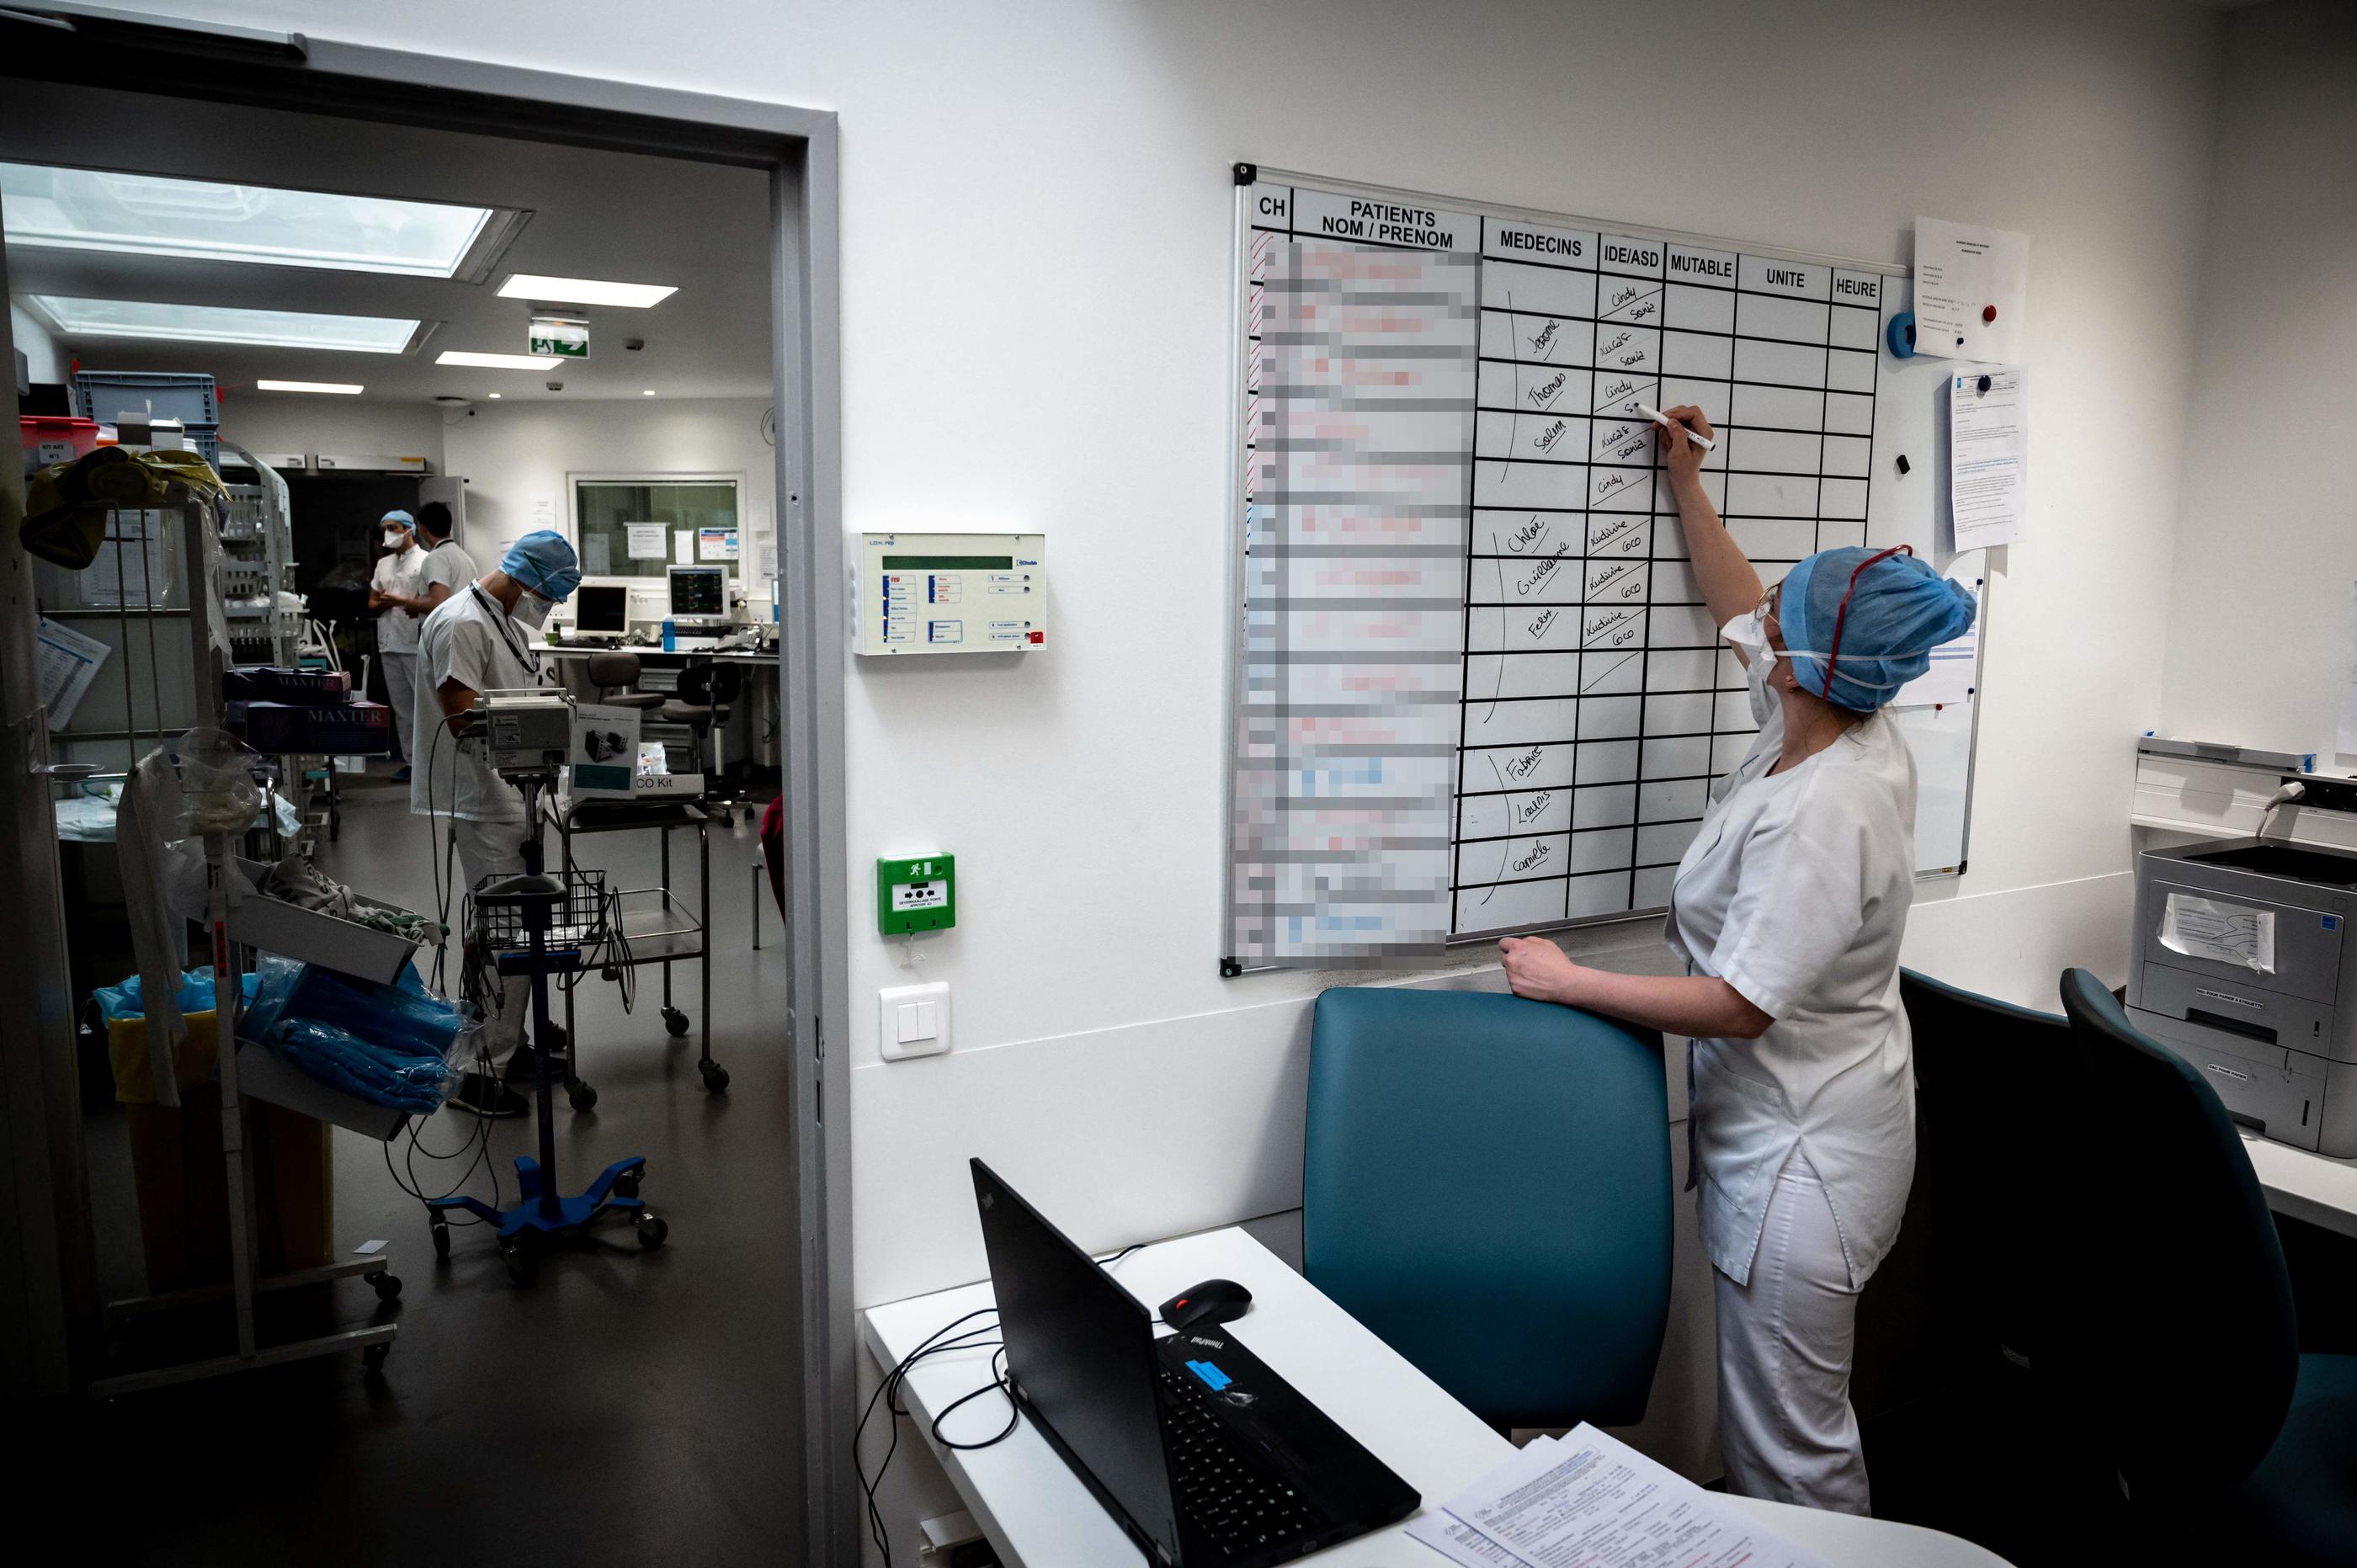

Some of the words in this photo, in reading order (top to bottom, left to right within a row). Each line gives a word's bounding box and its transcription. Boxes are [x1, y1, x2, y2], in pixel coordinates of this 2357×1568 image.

[1258, 197, 1285, 217] CH
[1350, 200, 1436, 227] PATIENTS
[1322, 215, 1364, 237] NOM
[1368, 223, 1375, 238] /
[1379, 223, 1454, 248] PRENOM
[1500, 230, 1582, 257] MEDECINS
[1604, 245, 1659, 267] IDE/ASD
[1670, 254, 1732, 277] MUTABLE
[1767, 268, 1806, 288] UNITE
[1836, 278, 1877, 297] HEURE
[1611, 286, 1638, 307] Cindy
[1527, 372, 1567, 407] Thomas
[1605, 379, 1636, 399] Cindy
[1598, 474, 1625, 494] Cindy
[1590, 520, 1628, 547] Ludivine
[1589, 565, 1625, 591] Ludivine
[1527, 609, 1552, 637] Felix
[1586, 611, 1628, 637] Ludivine
[276, 676, 336, 688] MAXTER
[307, 709, 382, 723] MAXTER
[1505, 745, 1543, 781] Fabrice
[657, 778, 673, 788] Kit
[1512, 839, 1551, 872] Camille
[1190, 1336, 1224, 1350] ThinkPad
